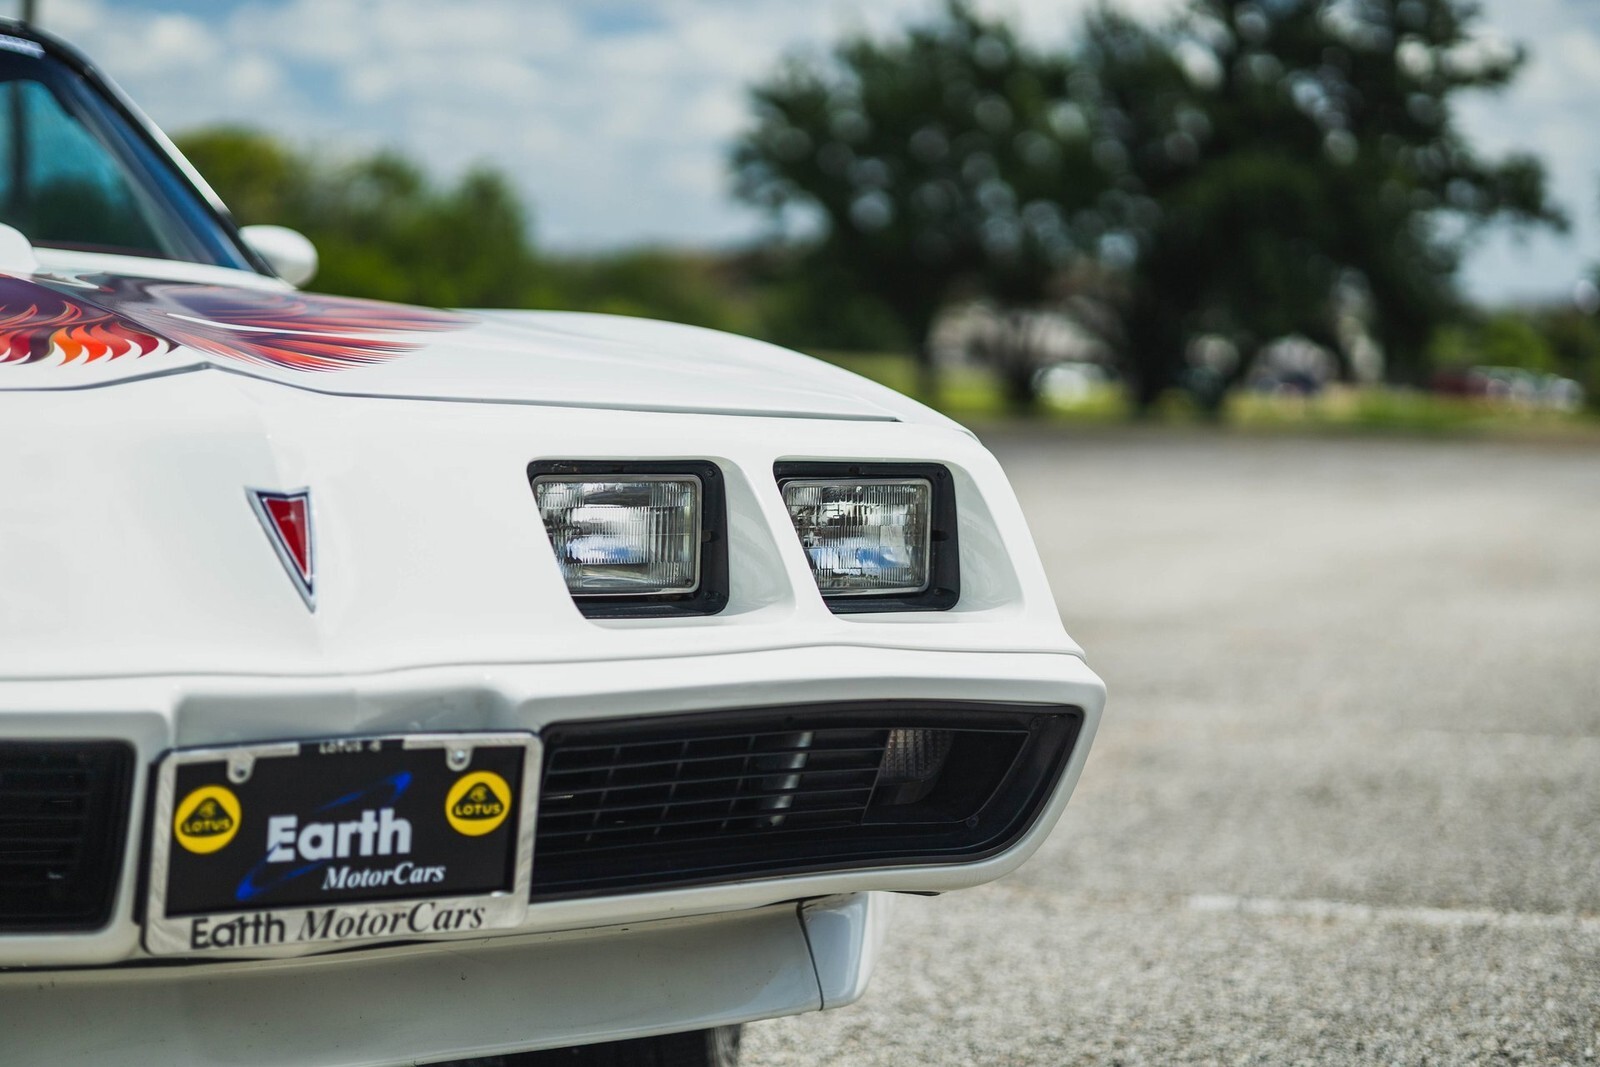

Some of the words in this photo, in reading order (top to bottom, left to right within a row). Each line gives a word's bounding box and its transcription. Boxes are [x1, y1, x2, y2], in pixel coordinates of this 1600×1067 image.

[455, 803, 502, 816] LOTUS
[183, 819, 231, 833] LOTUS
[266, 807, 412, 862] Earth
[321, 862, 445, 890] MotorCars
[190, 913, 285, 950] Earth
[297, 902, 485, 941] MotorCars
